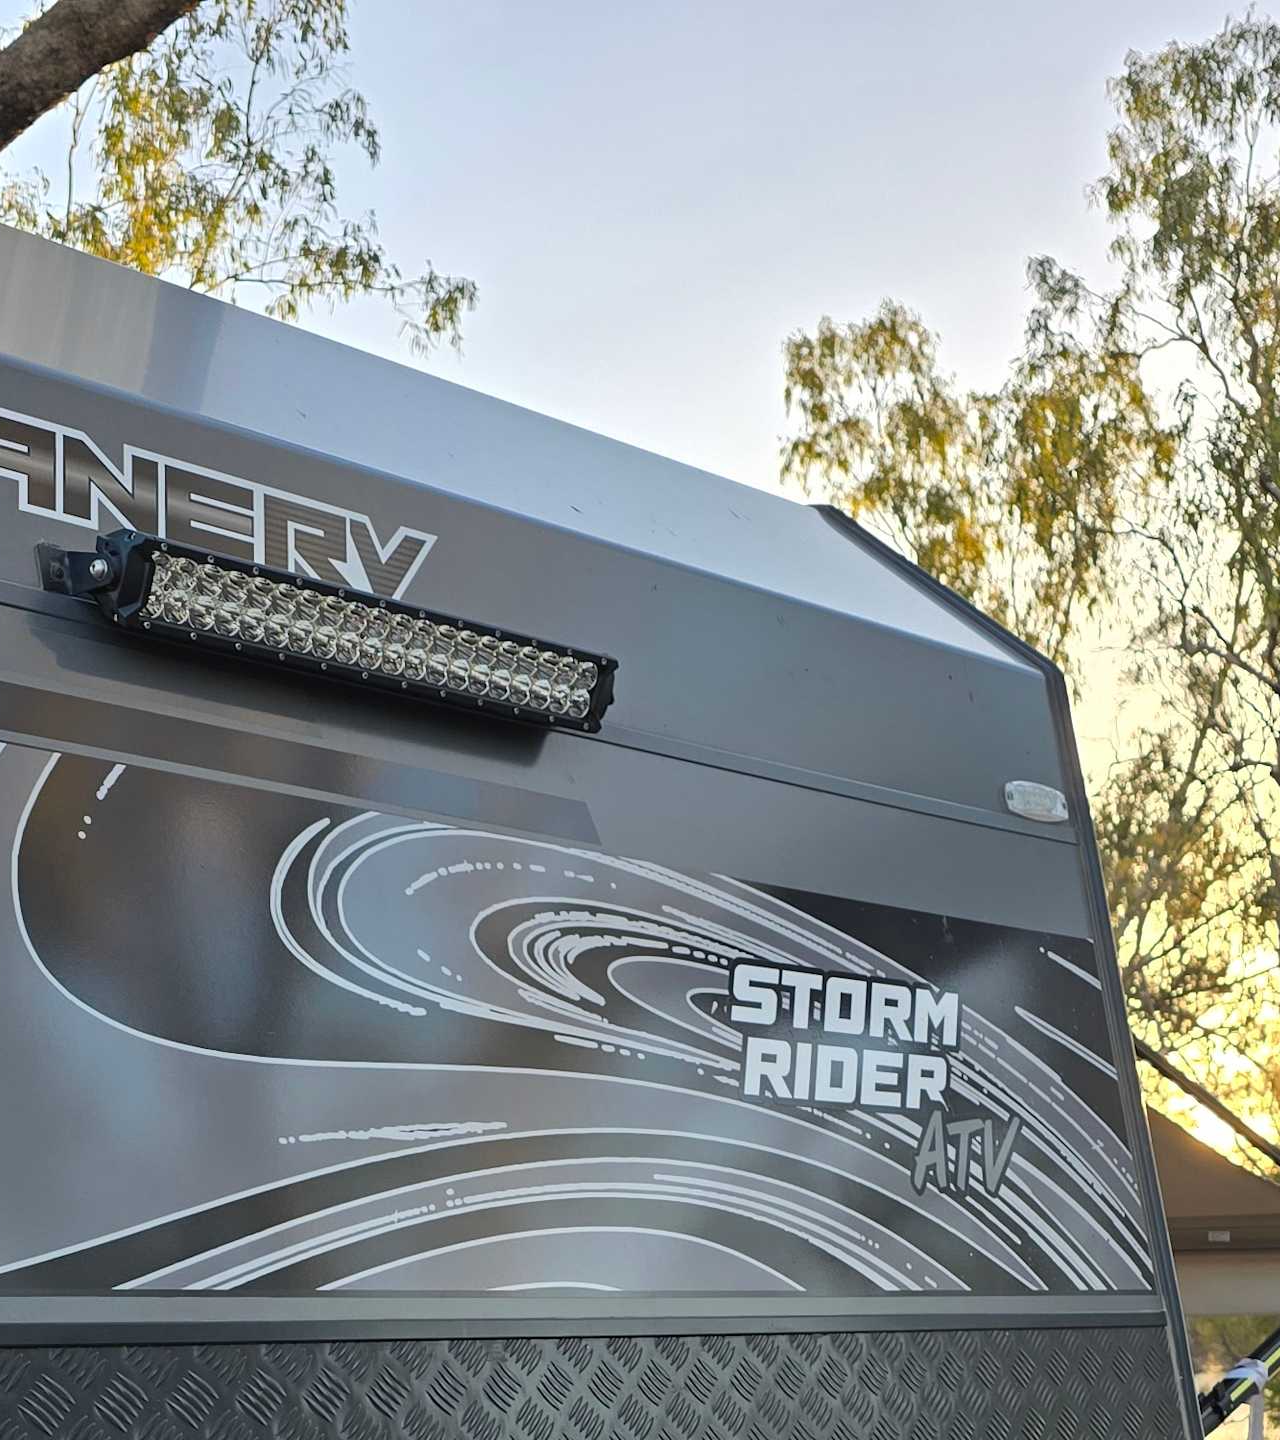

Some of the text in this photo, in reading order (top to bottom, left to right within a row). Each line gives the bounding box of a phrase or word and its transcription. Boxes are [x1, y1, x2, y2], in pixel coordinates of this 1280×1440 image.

[730, 962, 960, 1047] STORM
[742, 1036, 950, 1112] RIDER
[913, 1108, 1020, 1195] ATV
